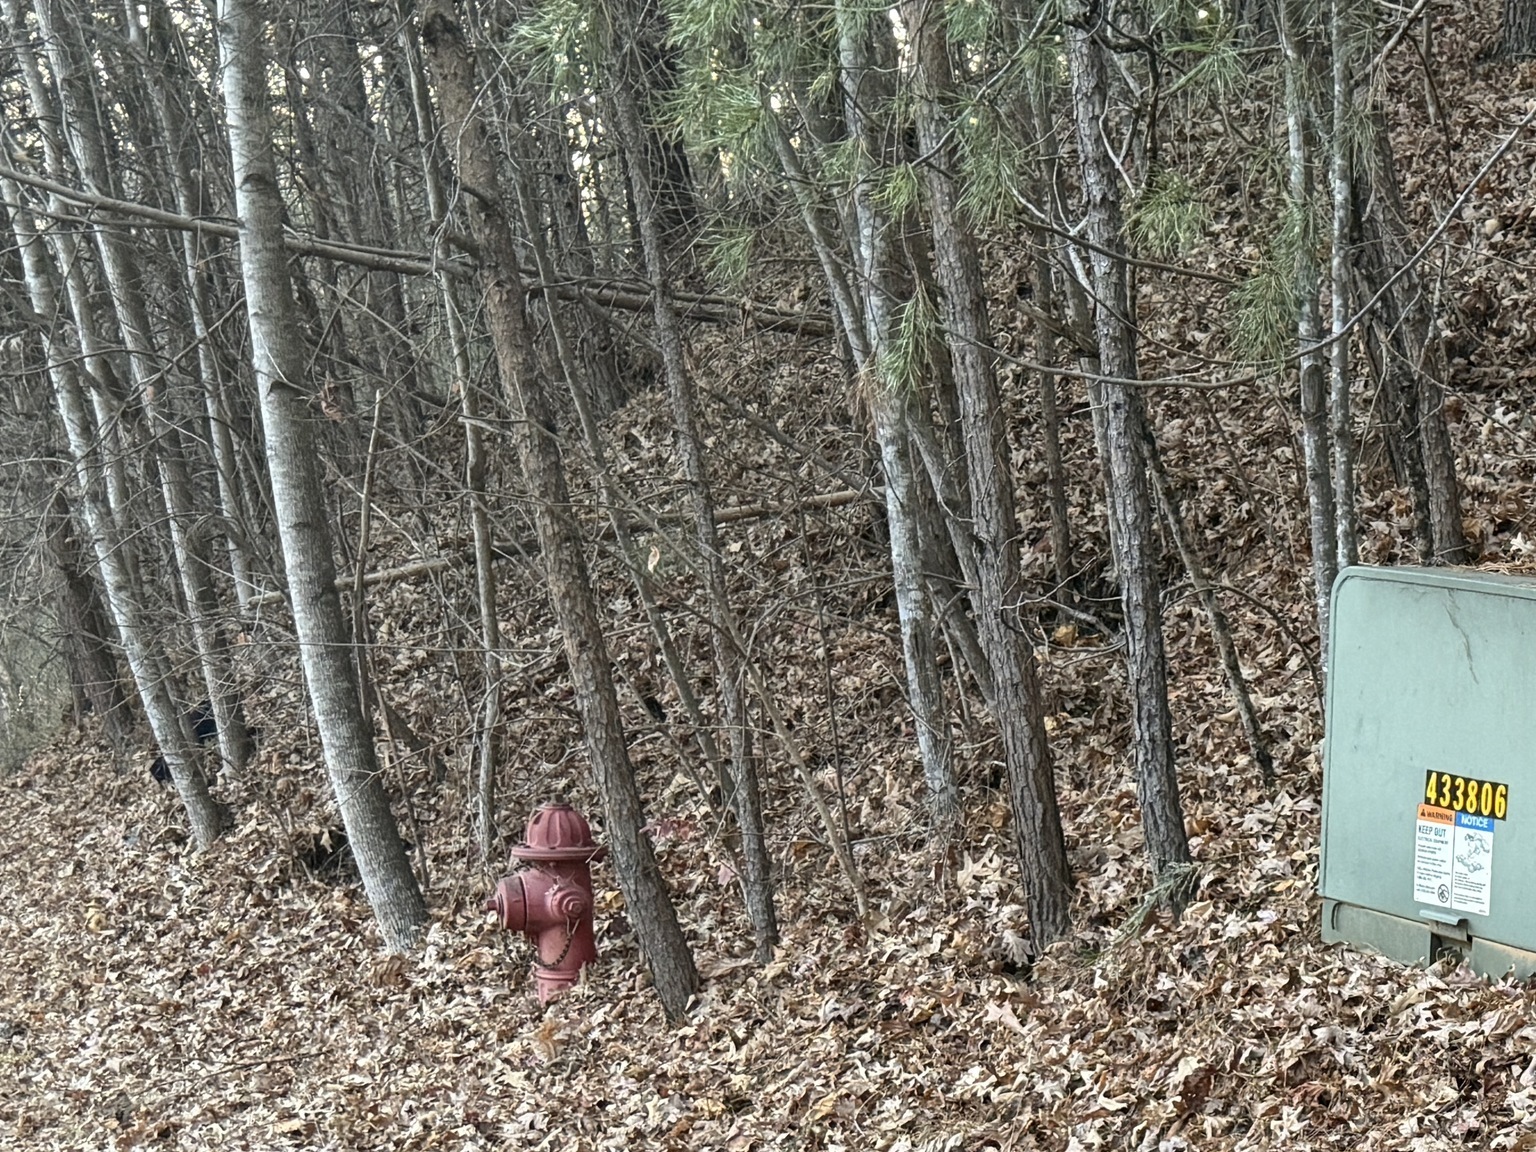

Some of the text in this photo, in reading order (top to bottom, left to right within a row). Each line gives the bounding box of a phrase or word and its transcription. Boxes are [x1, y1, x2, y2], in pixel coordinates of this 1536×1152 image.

[1426, 771, 1507, 819] 433806
[1426, 810, 1453, 822] WARNING
[1461, 813, 1489, 828] NOTICE
[1418, 824, 1447, 838] KEEP OUT
